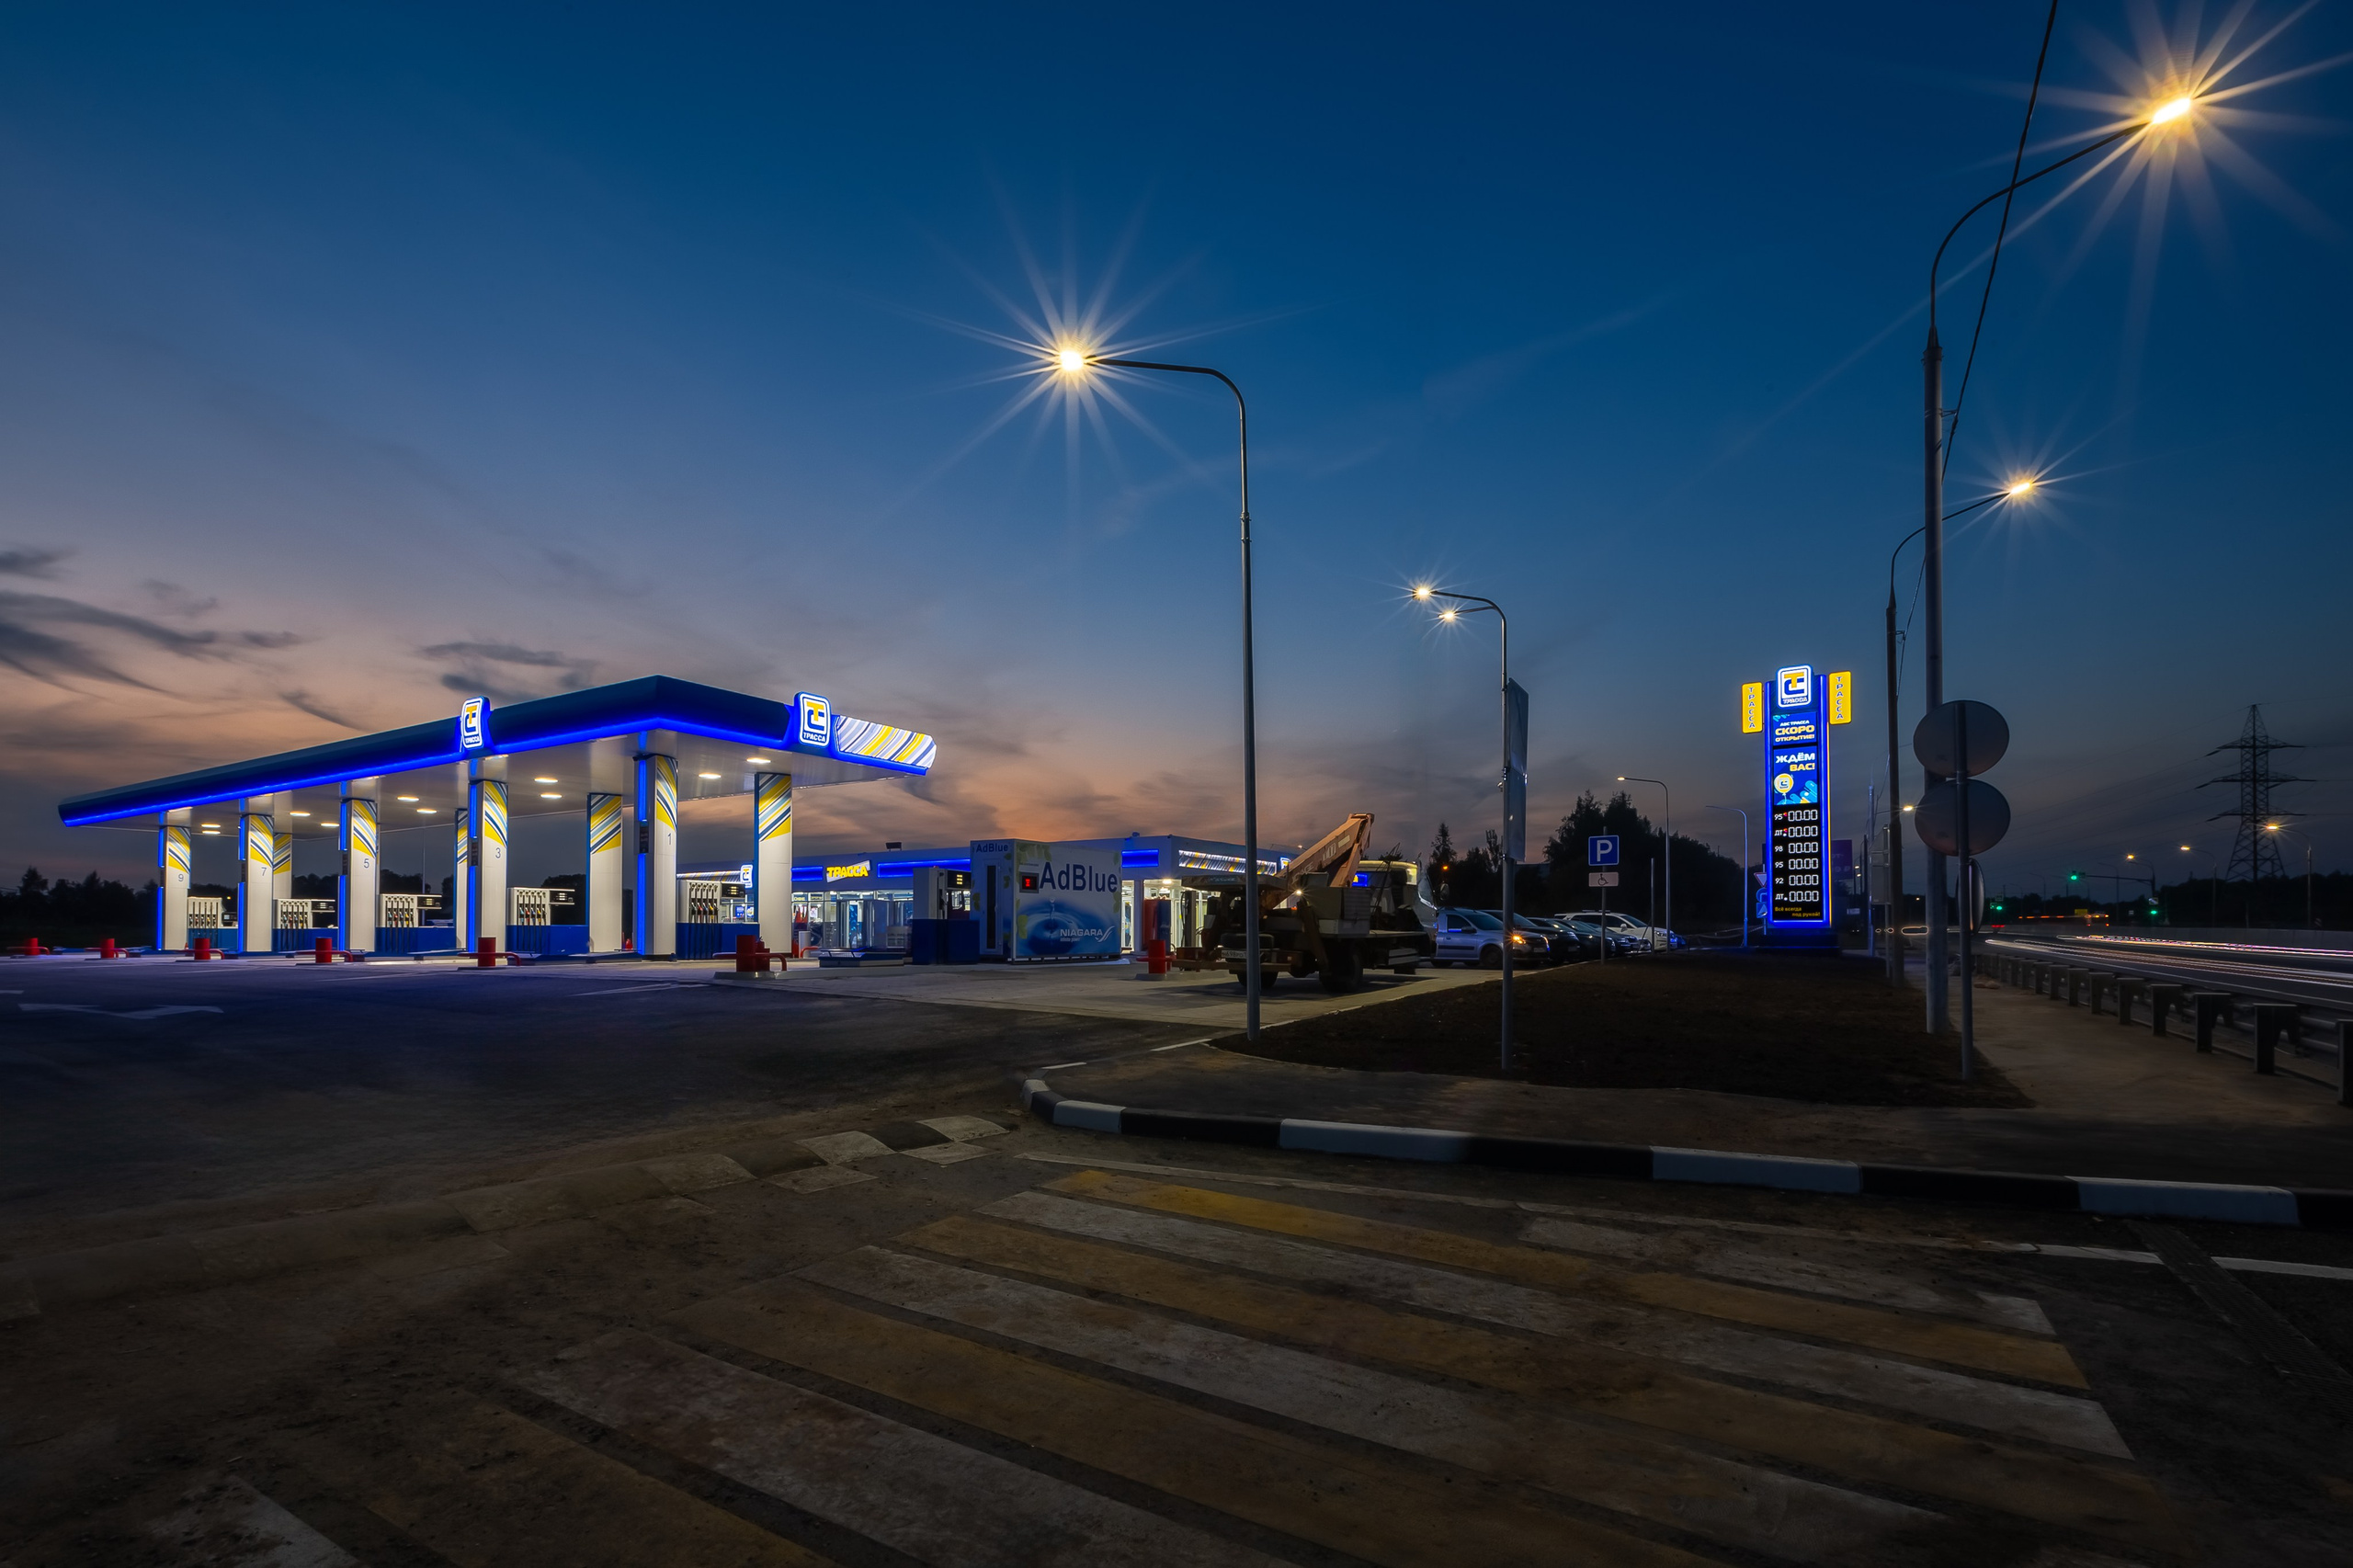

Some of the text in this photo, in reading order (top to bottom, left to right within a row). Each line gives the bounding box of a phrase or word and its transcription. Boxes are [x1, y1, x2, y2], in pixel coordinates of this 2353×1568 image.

[1782, 697, 1808, 705] ТРАССА
[1775, 725, 1814, 735] СКОРО
[803, 732, 826, 743] ТРАССА
[1775, 753, 1814, 763] ЖДЁМ
[1790, 763, 1815, 772] ВАС!
[495, 847, 501, 858] 3
[976, 843, 1008, 853] AdBlue
[1597, 839, 1613, 862] P
[363, 858, 369, 869] 5
[261, 867, 267, 877] 7
[826, 866, 869, 878] ТРАССА
[1039, 861, 1118, 892] AdBlue
[177, 873, 184, 882] 9
[1060, 928, 1103, 937] NIAGARA
